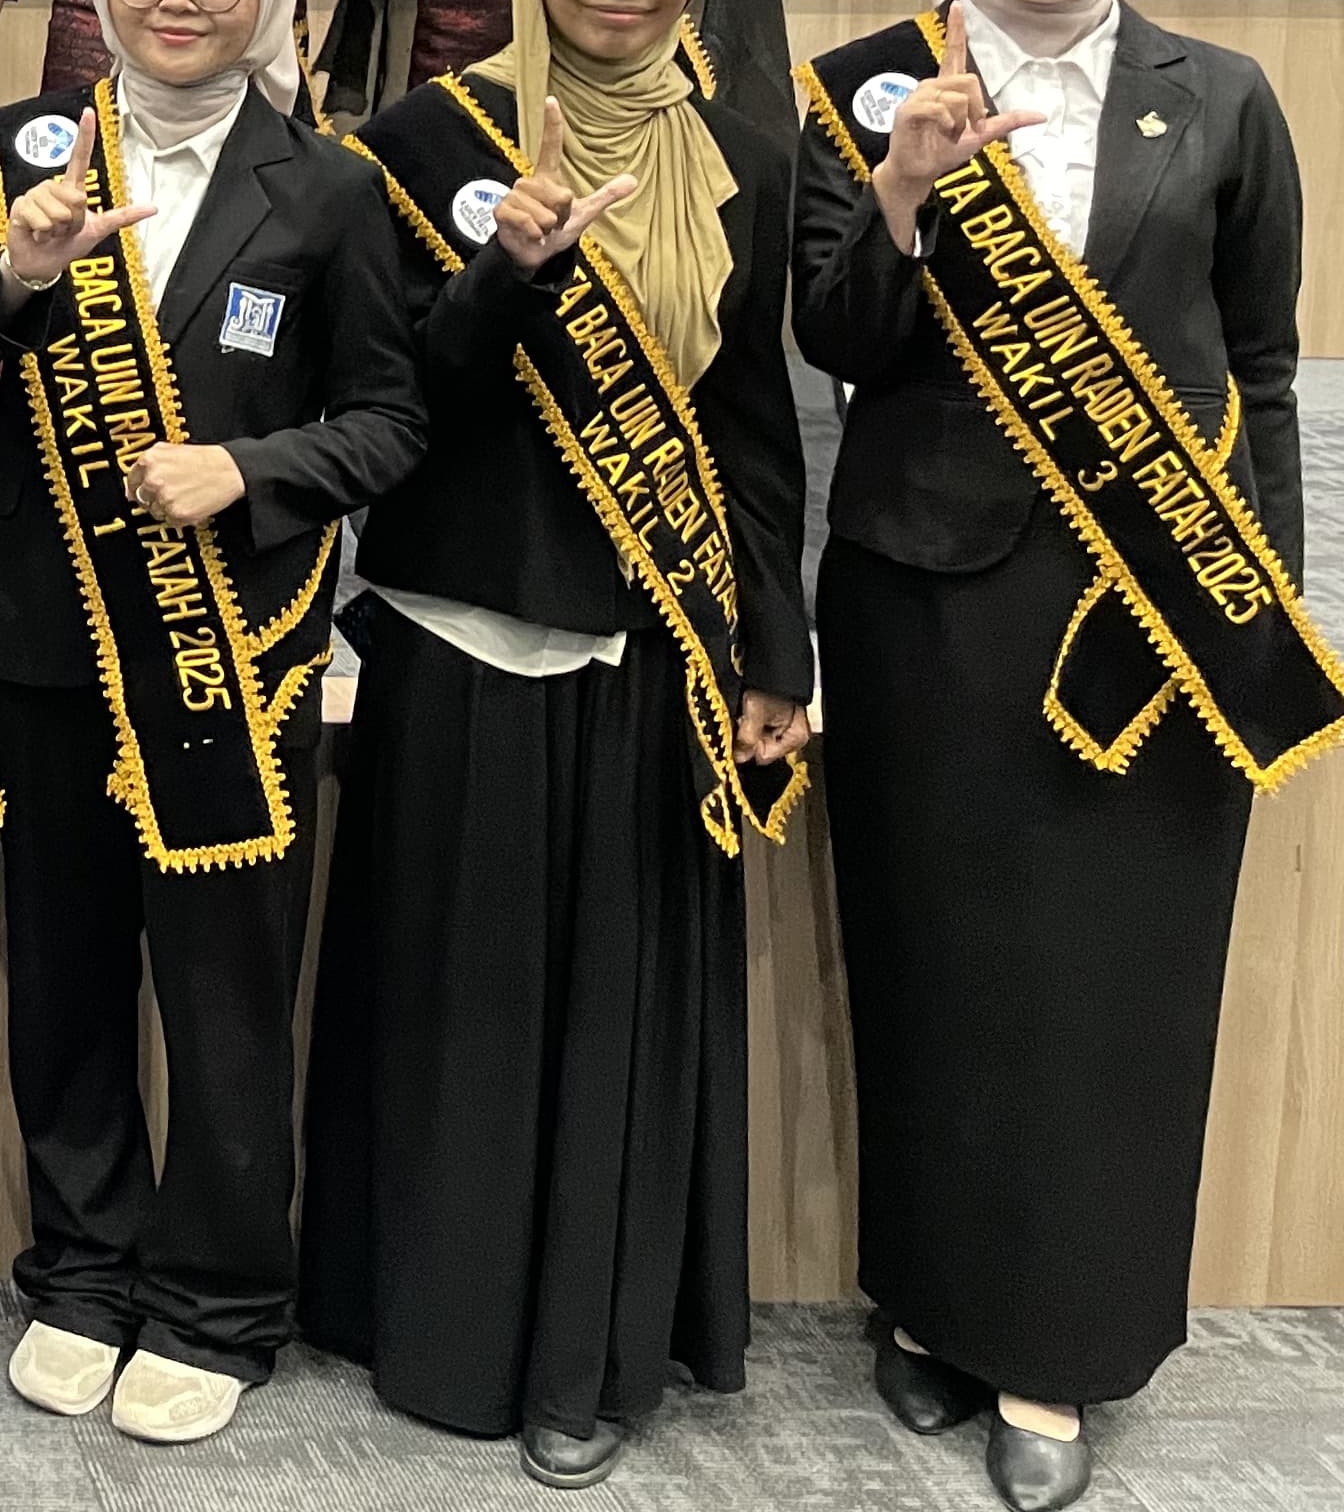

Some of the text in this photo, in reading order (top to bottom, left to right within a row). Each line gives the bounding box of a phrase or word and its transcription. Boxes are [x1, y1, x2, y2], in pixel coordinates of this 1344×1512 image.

[69, 255, 127, 358] BACA
[89, 340, 145, 406] UIN
[934, 158, 1274, 625] TA BACA UIN RADEN FATAH 2025
[970, 300, 1118, 492] WAKIL 3
[47, 331, 126, 536] WAKIL 1
[565, 304, 635, 396] BACA
[609, 380, 668, 452] UIN
[644, 435, 708, 544] RADEN
[579, 409, 696, 596] WAKIL 2
[169, 624, 233, 713] 2025
